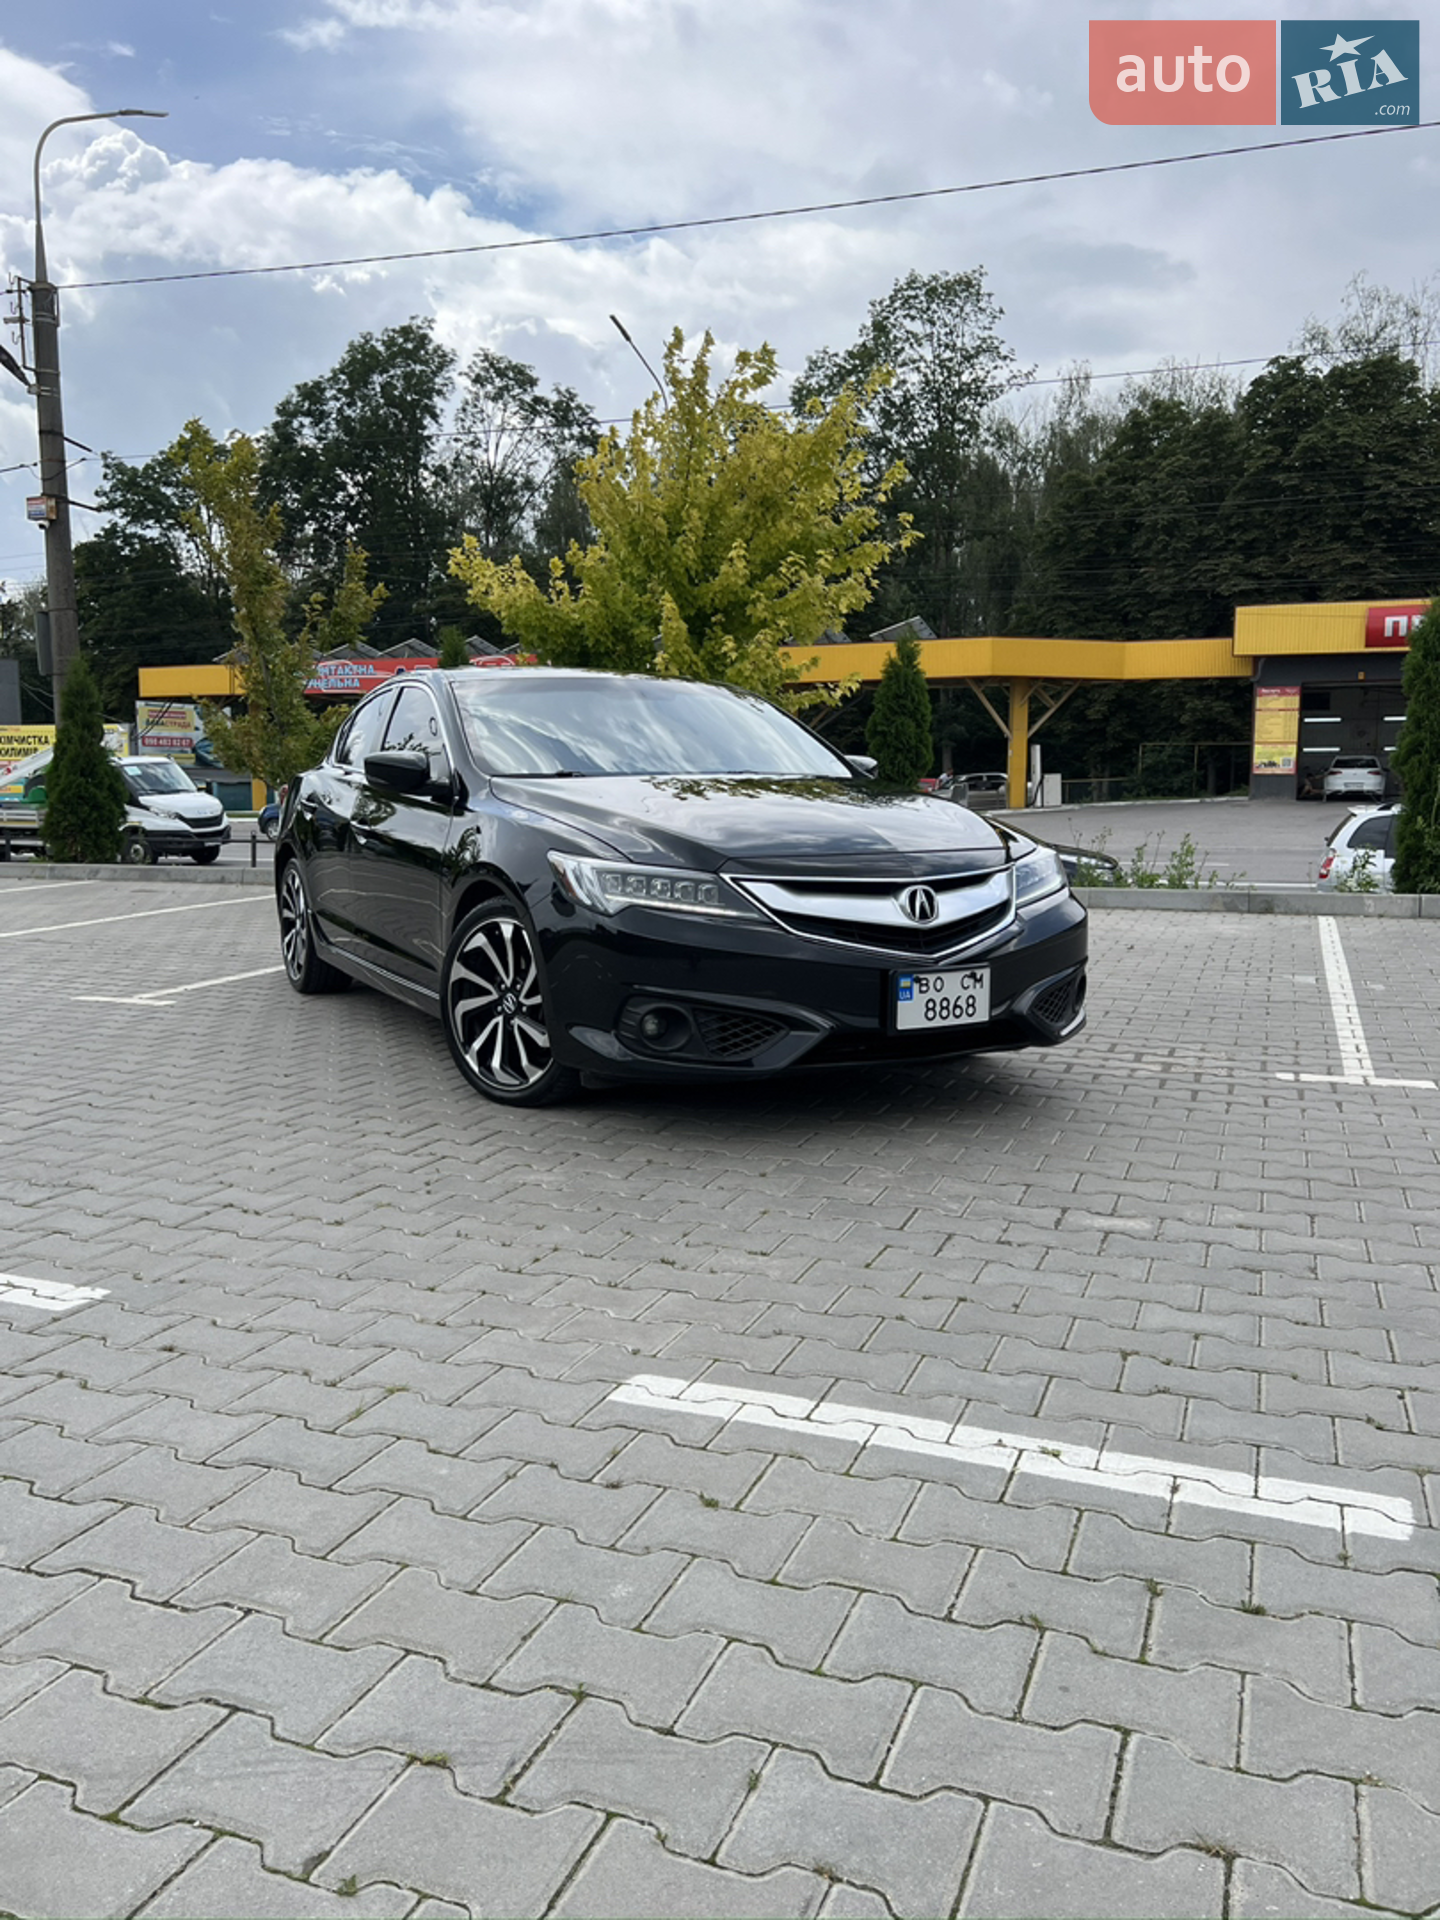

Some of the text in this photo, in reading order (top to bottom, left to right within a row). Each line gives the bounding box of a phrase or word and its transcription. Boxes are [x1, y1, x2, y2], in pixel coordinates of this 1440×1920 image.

[918, 975, 945, 994] BO
[899, 990, 912, 1000] UA
[924, 994, 977, 1022] 8868
